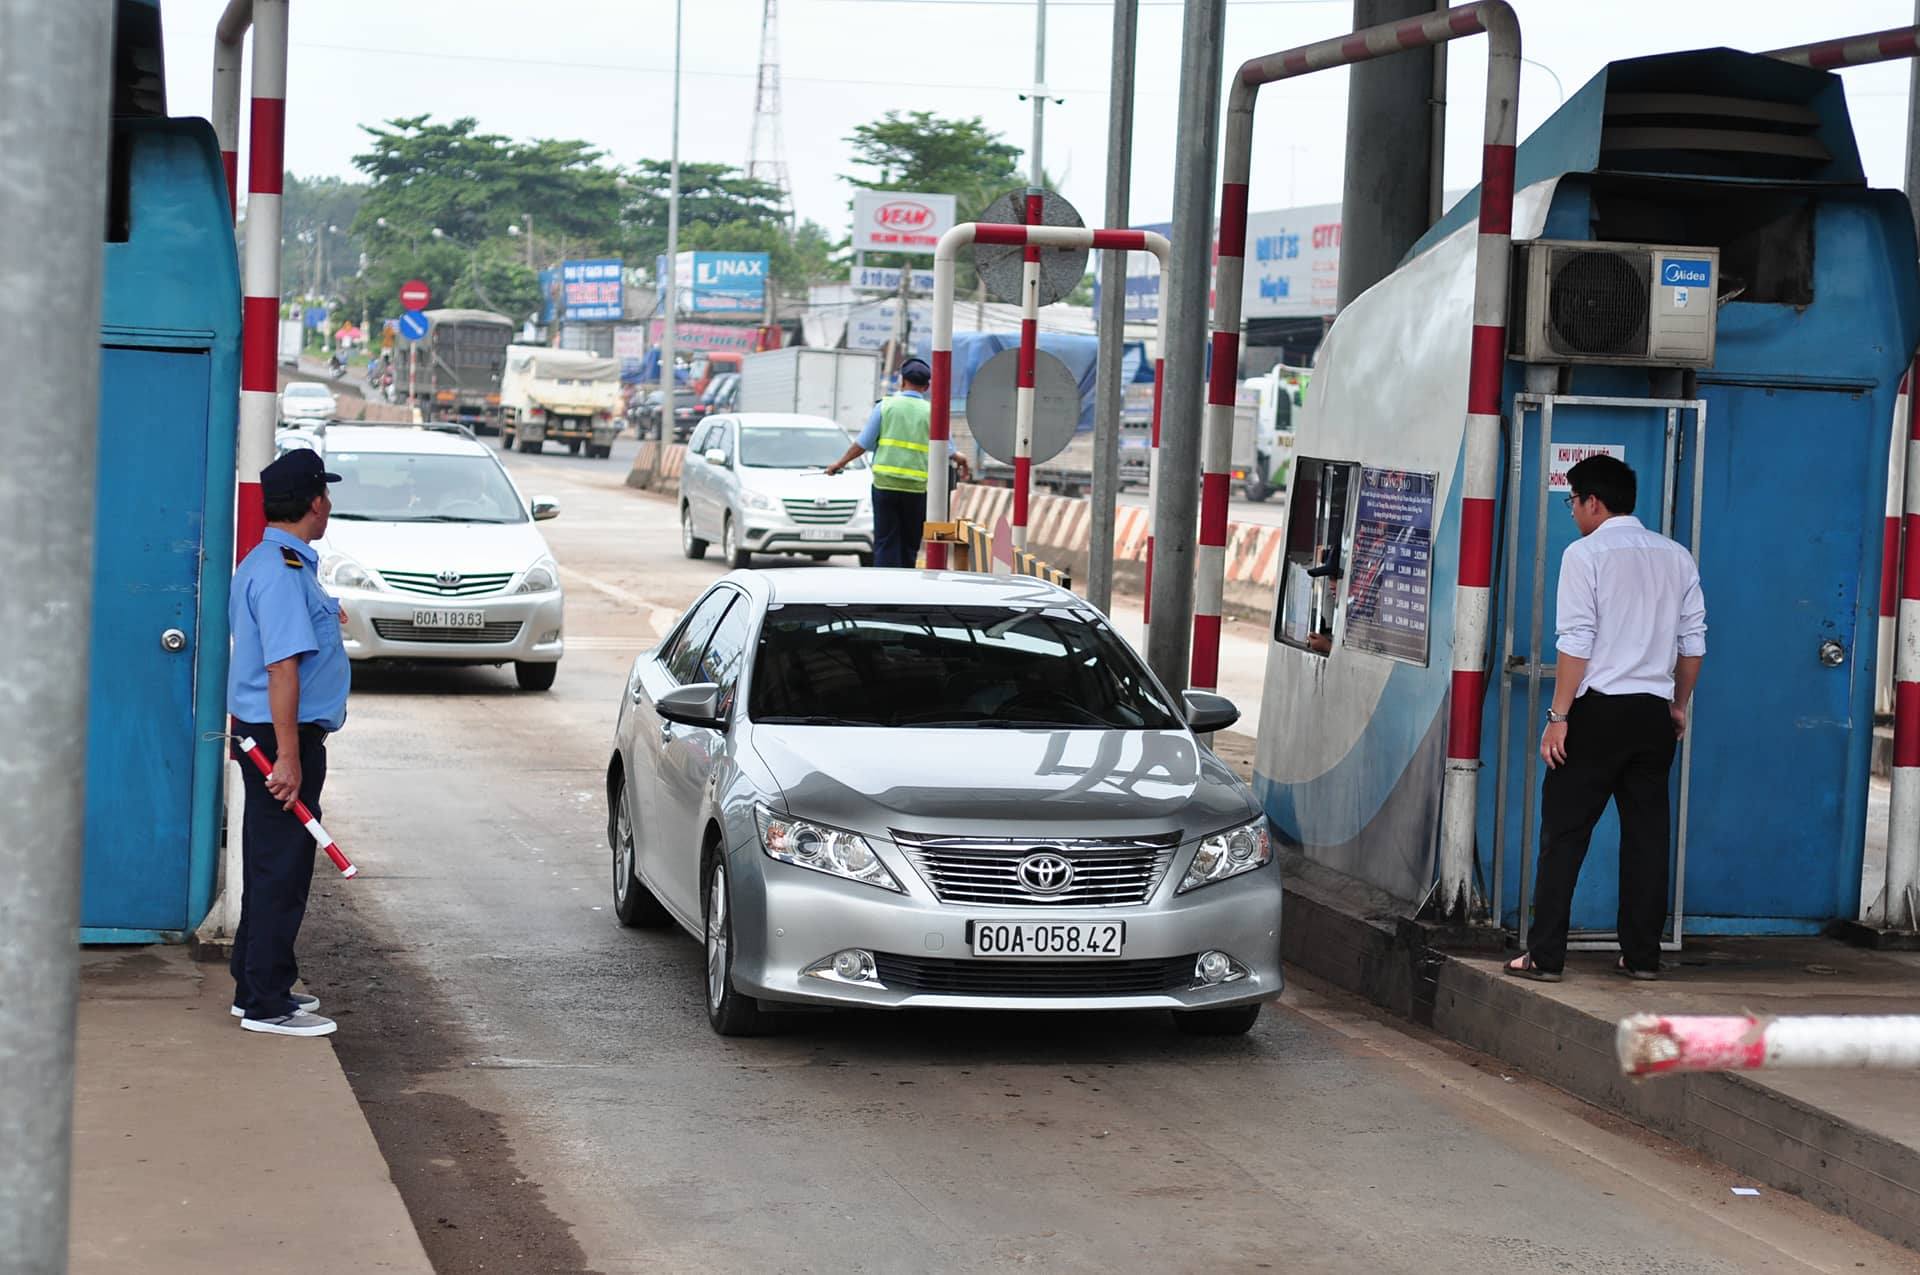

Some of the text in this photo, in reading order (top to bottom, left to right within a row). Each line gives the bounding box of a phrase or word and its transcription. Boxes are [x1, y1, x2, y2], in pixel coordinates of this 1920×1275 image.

[1665, 263, 1706, 282] Midea
[416, 611, 482, 626] 60A-183.63
[979, 926, 1116, 953] 60A-058.42
